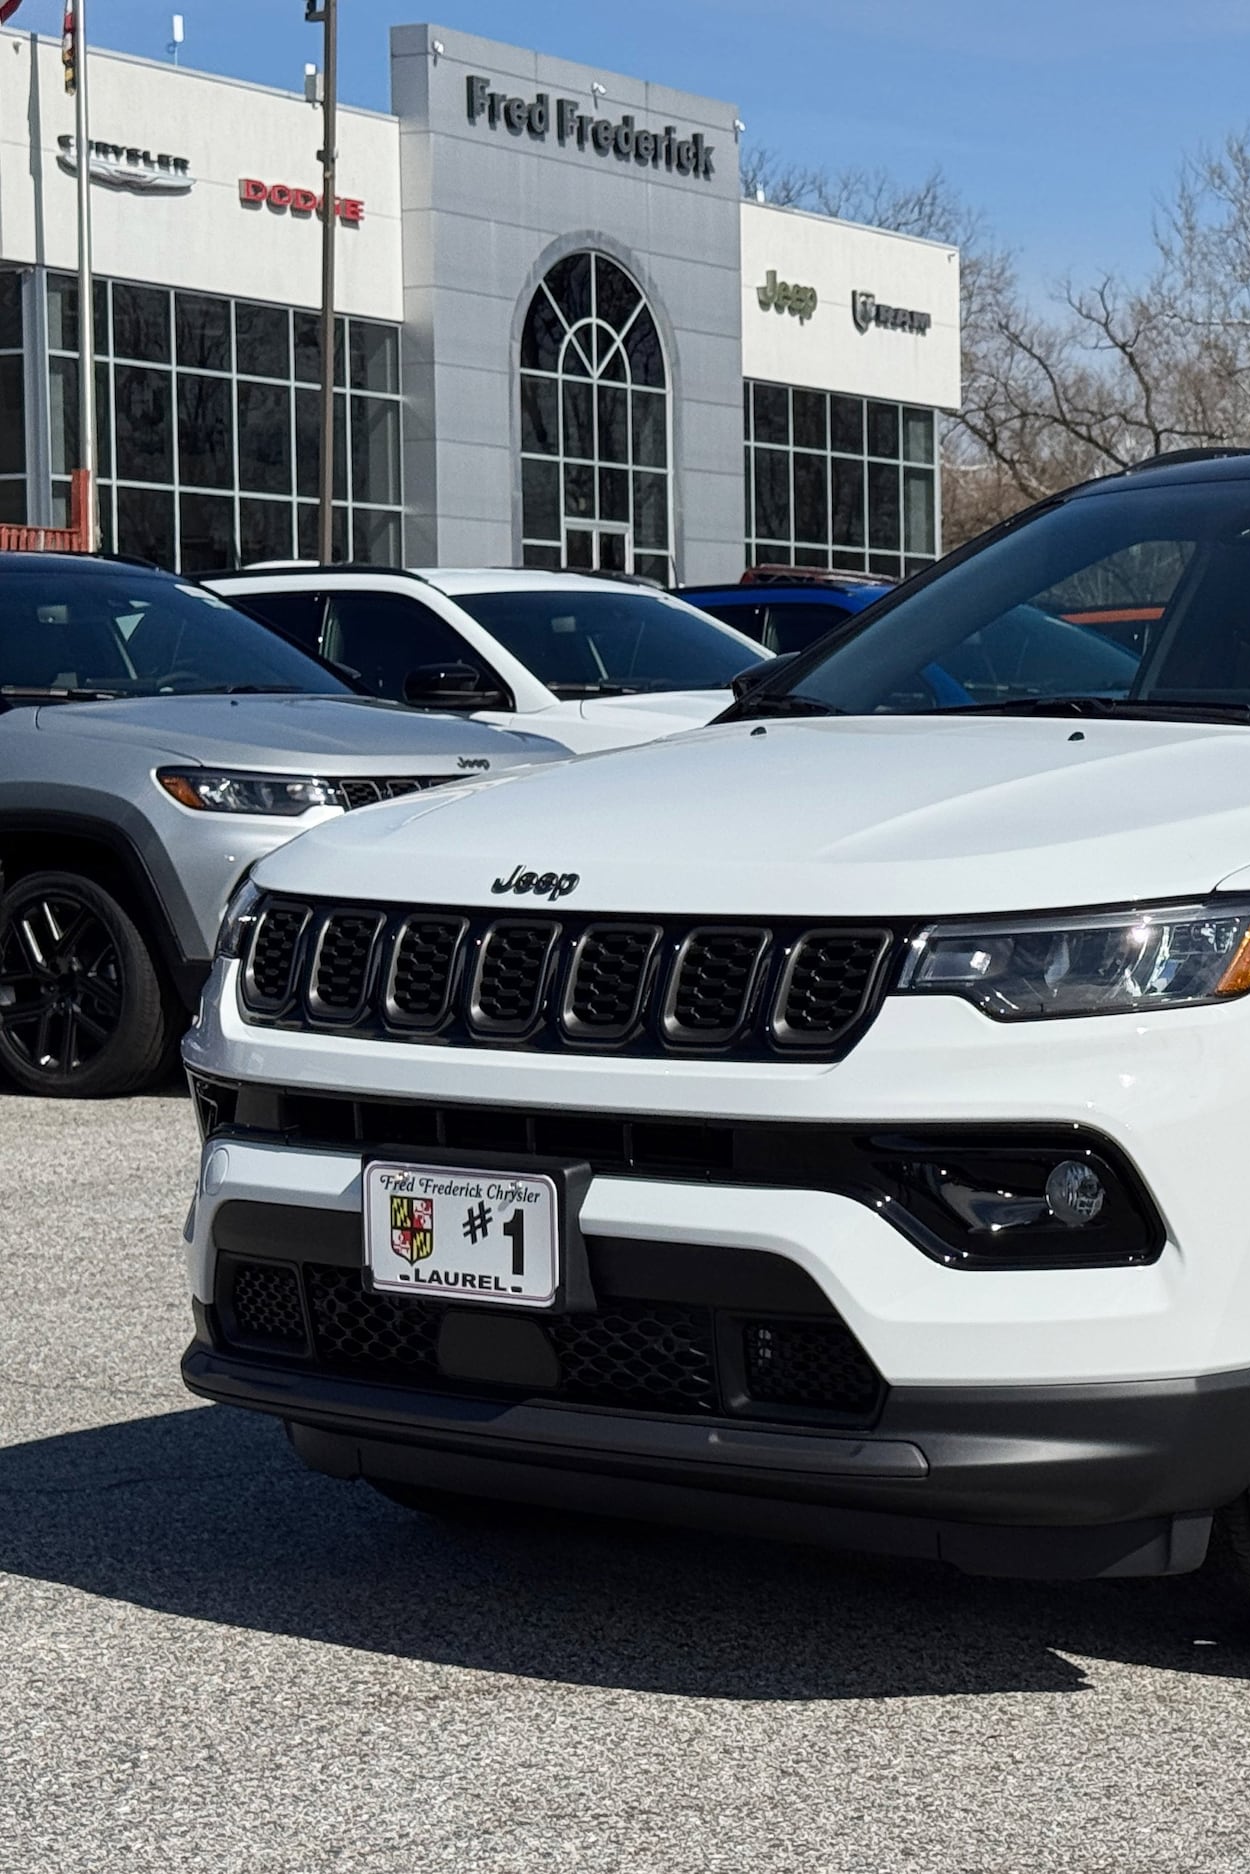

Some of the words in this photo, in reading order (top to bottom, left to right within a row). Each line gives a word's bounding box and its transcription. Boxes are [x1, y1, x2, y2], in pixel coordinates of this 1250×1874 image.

[466, 75, 550, 141] Fred
[556, 99, 716, 181] Frederick
[757, 270, 818, 325] Jeep
[457, 756, 491, 771] Jeep
[491, 865, 580, 902] Jeep
[379, 1174, 415, 1192] Fred
[418, 1177, 483, 1199] Frederick
[486, 1184, 541, 1204] Chrysler
